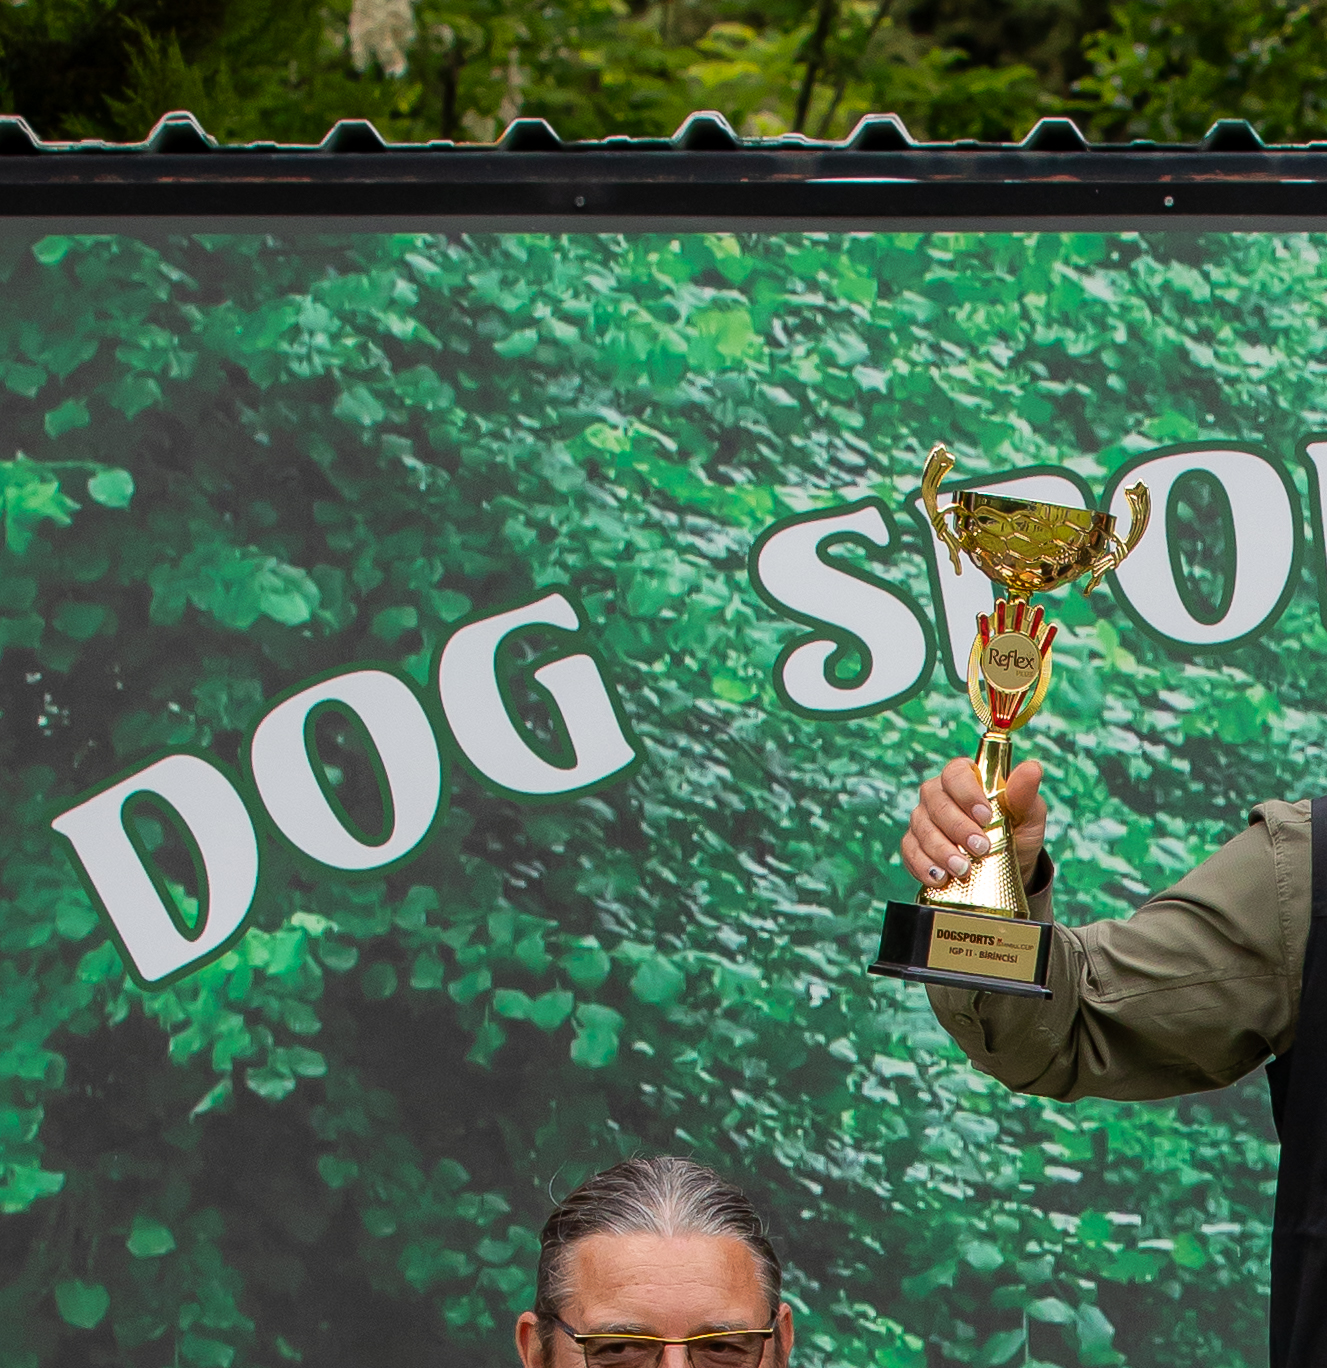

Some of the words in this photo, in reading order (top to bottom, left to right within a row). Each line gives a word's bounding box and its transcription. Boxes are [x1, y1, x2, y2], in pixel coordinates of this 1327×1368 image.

[989, 647, 1035, 671] Reflex
[52, 594, 635, 981] DOG
[936, 928, 996, 946] DOGSPORTS
[949, 946, 965, 955] IGP
